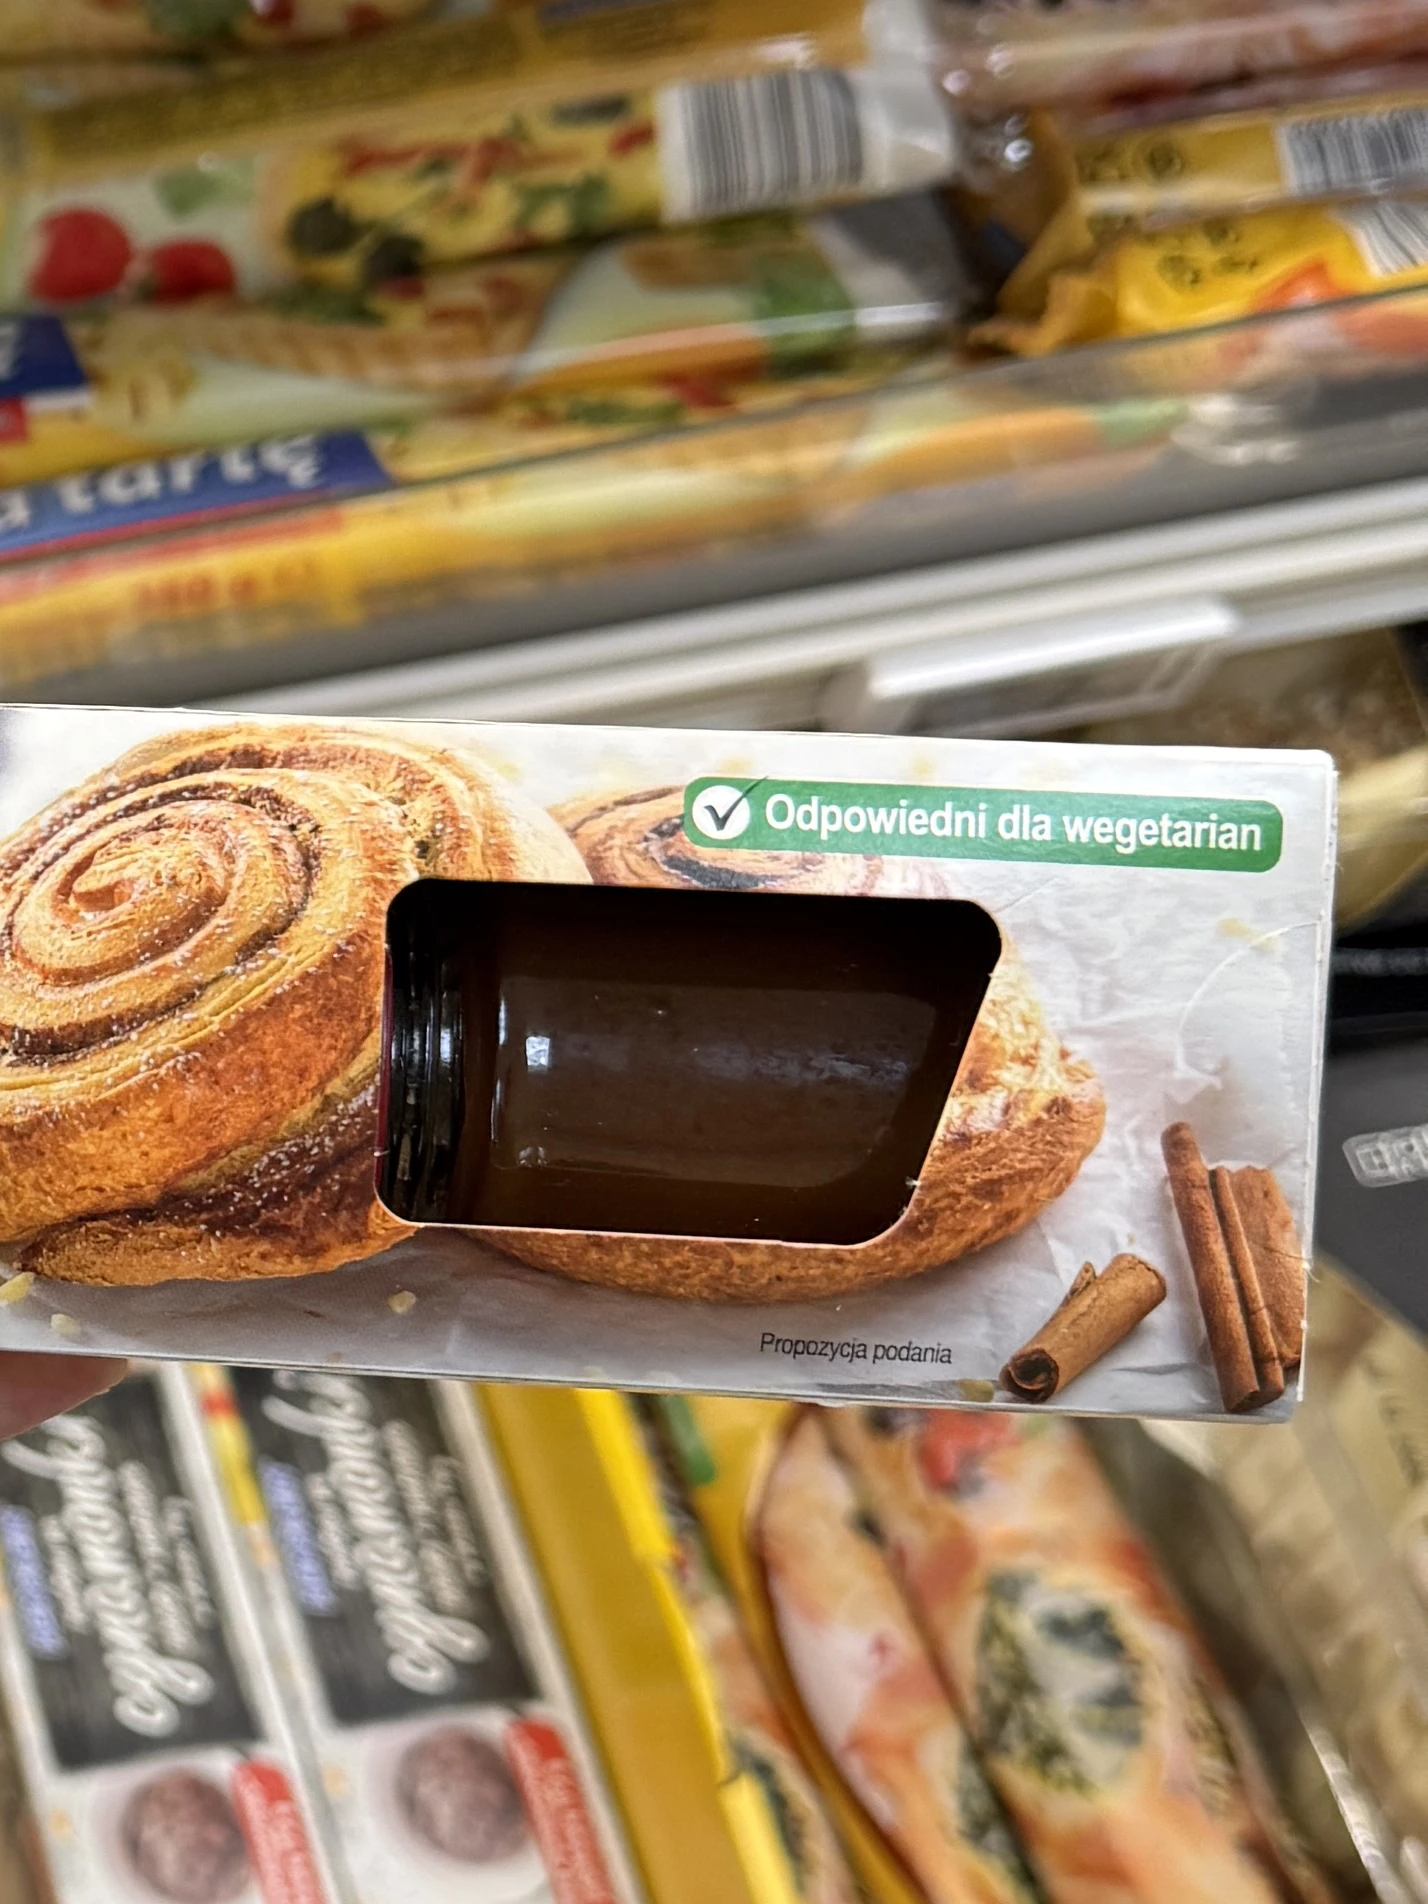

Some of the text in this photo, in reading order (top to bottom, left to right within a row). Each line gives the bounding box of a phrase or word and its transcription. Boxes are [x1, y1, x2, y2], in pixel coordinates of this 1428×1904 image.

[765, 792, 1262, 856] Odpowiedni dla wegetarian
[760, 1331, 953, 1366] Propozycja podania
